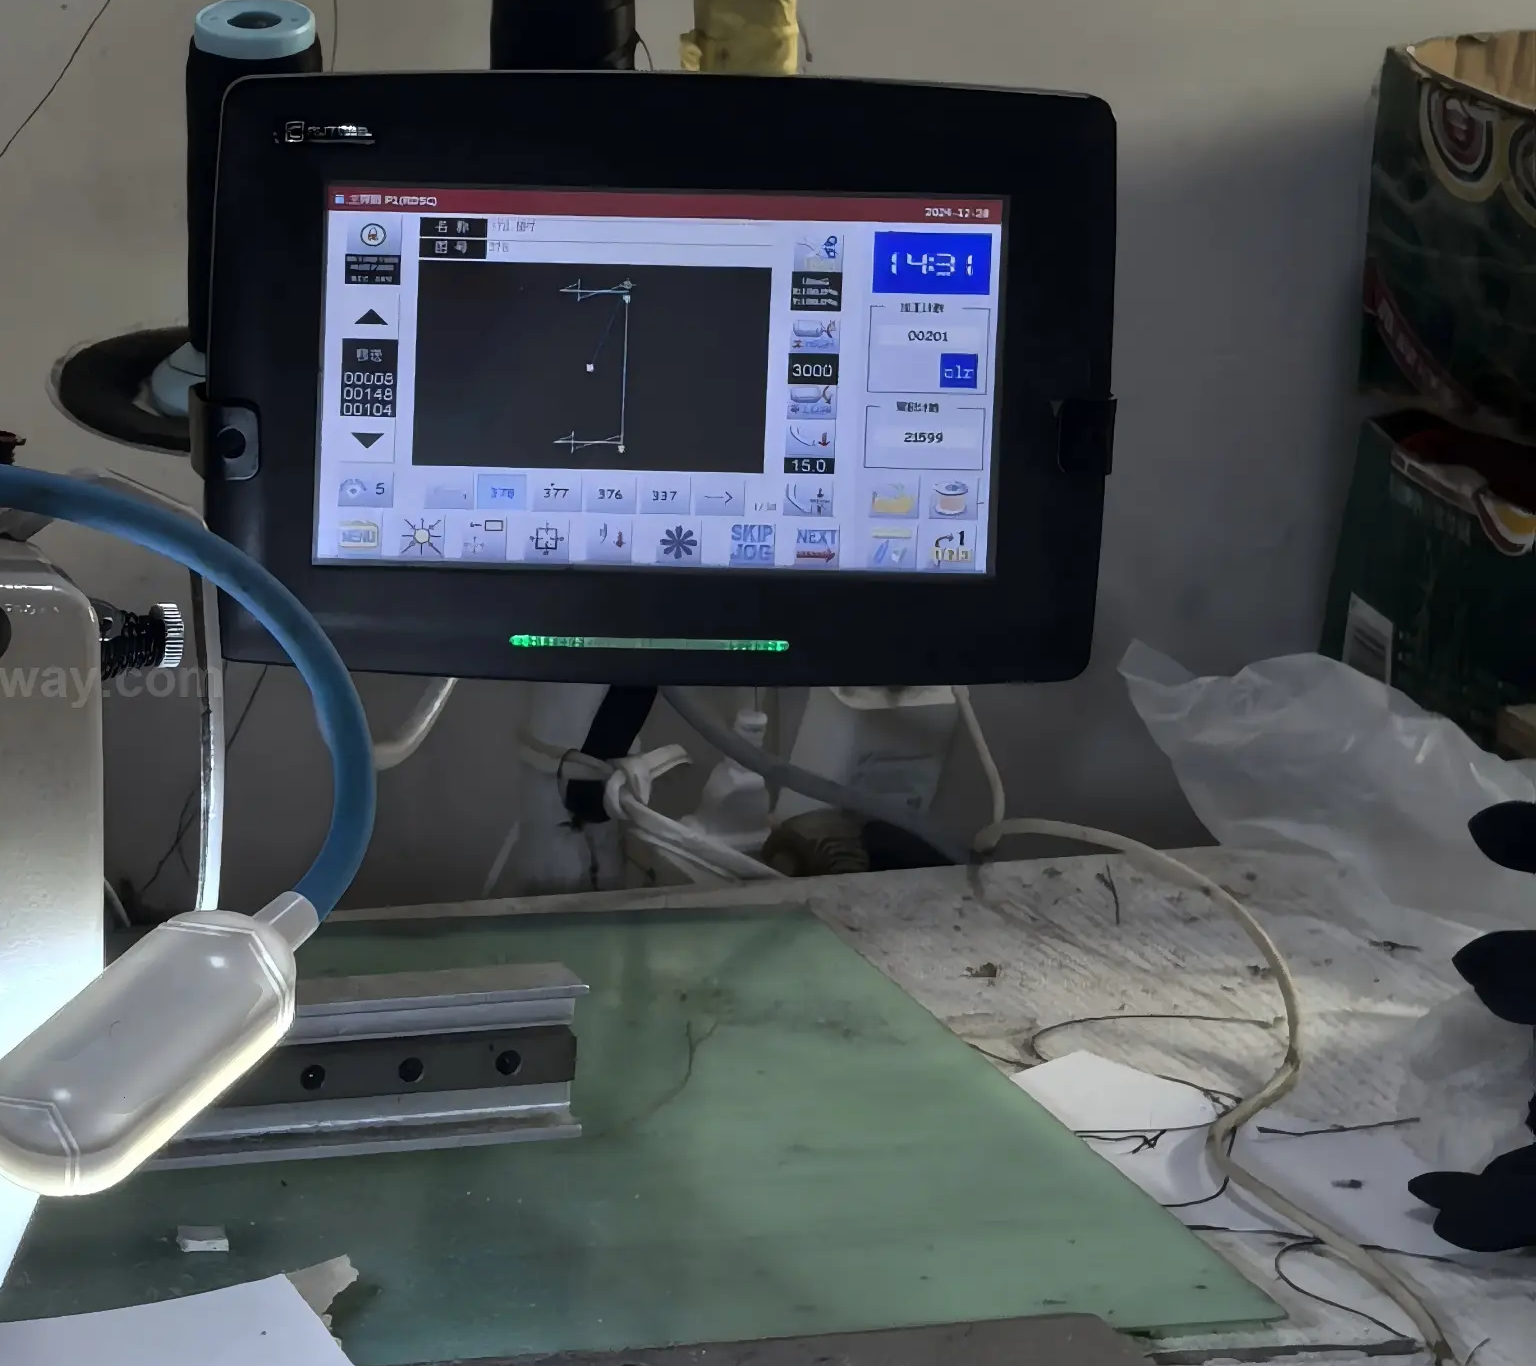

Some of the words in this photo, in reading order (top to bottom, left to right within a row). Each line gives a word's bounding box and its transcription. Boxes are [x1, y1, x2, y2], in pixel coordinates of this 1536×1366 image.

[891, 252, 974, 276] 14:31
[792, 363, 832, 377] 3000
[344, 387, 393, 400] 00148
[343, 402, 392, 416] 00104
[904, 432, 944, 444] 21599
[791, 459, 826, 473] 15.0
[375, 482, 385, 495] 5
[731, 524, 773, 543] SKIP
[796, 529, 837, 545] NEXT
